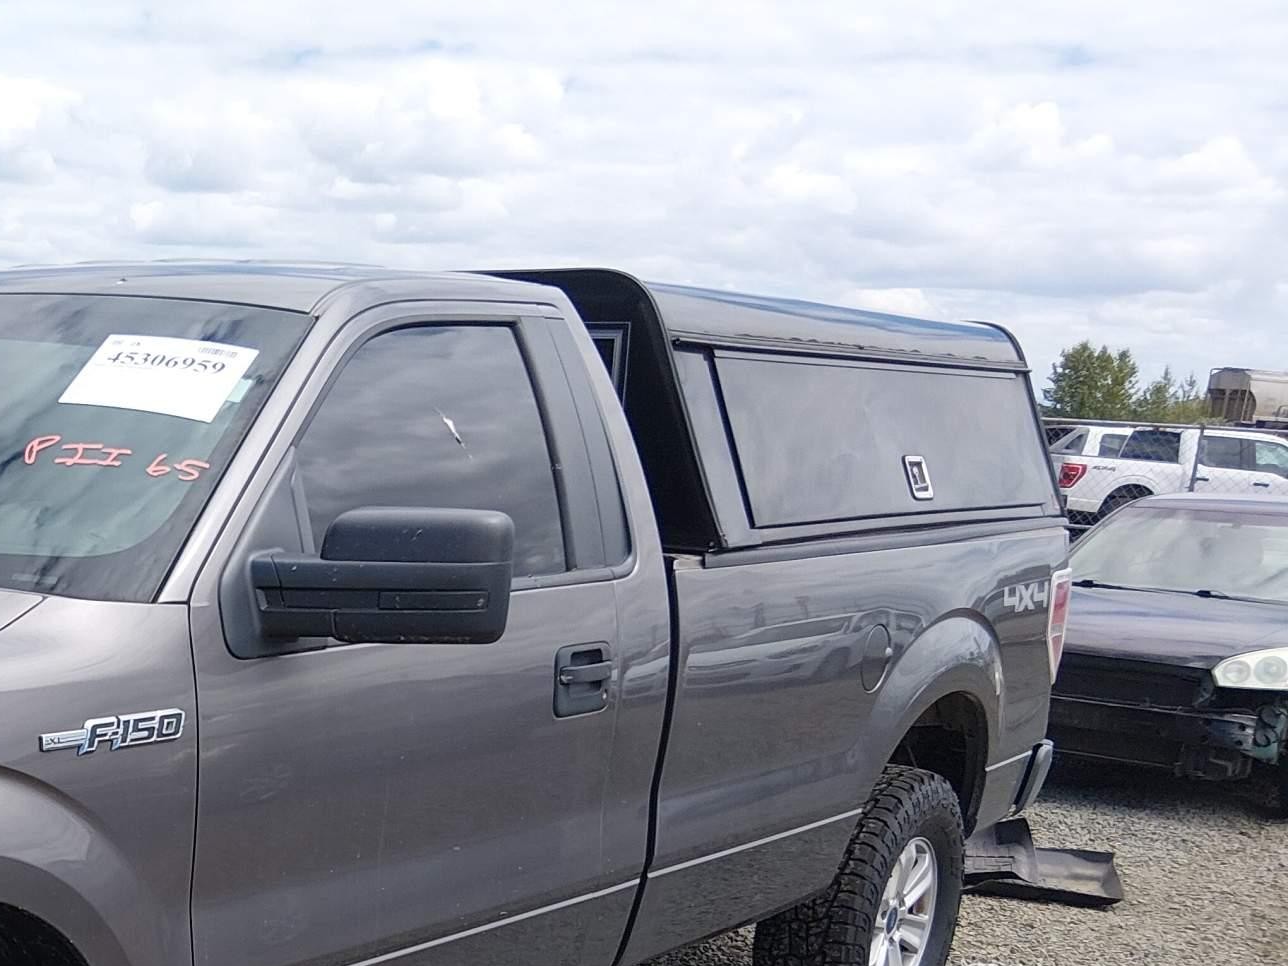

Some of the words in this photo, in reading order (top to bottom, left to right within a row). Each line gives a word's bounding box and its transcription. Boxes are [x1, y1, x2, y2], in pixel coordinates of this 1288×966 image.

[107, 350, 226, 375] 45306959
[145, 453, 211, 482] 65
[78, 708, 185, 756] F-150
